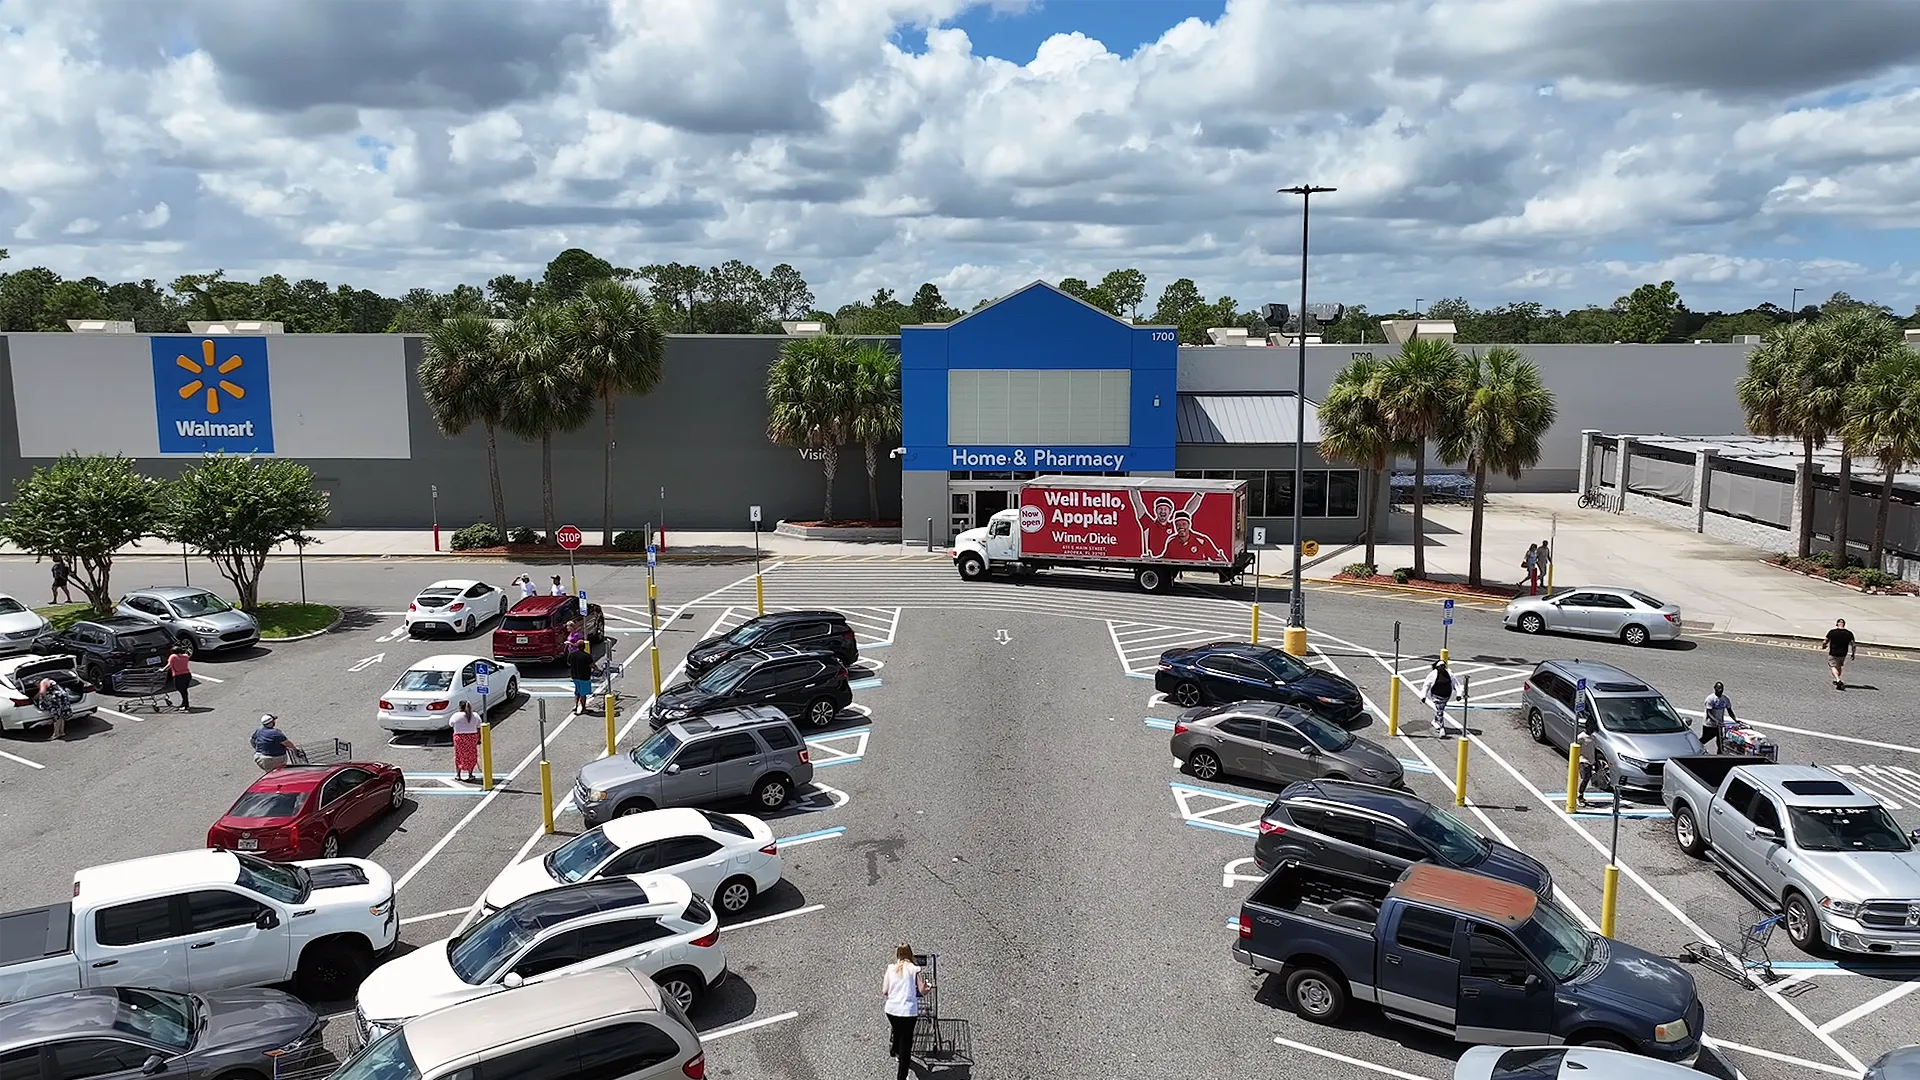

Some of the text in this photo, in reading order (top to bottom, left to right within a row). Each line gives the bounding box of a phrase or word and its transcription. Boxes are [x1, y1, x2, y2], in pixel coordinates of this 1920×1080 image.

[1152, 332, 1175, 341] 1700
[175, 420, 254, 437] Walmart
[952, 449, 1124, 471] Home & Pharmacy
[1044, 491, 1126, 511] Well hello,
[753, 509, 758, 518] 6
[1051, 508, 1118, 528] Apopka!
[1021, 520, 1041, 528] open
[559, 532, 581, 543] STOP
[1257, 531, 1263, 541] 5
